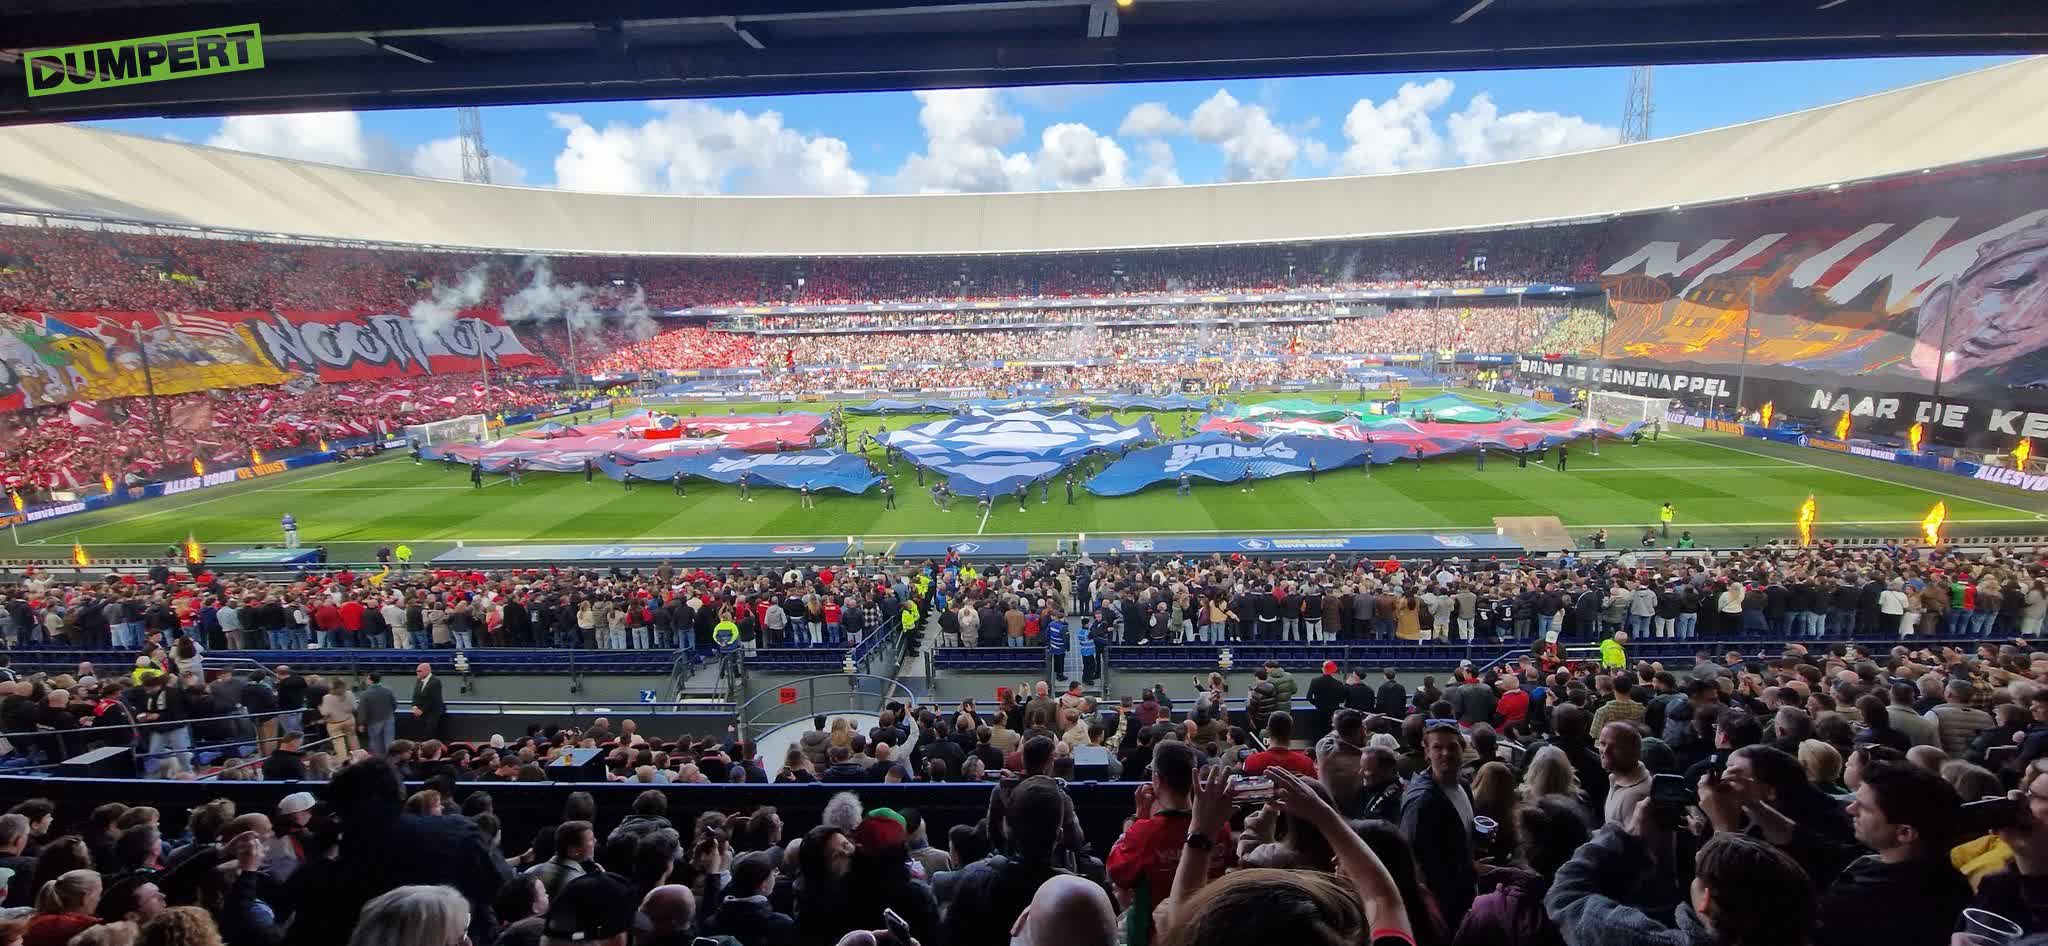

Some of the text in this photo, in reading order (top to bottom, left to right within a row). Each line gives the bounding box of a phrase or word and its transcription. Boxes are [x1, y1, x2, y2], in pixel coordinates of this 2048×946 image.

[1520, 360, 1563, 376] BRING
[1567, 365, 1587, 380] DE
[1811, 389, 1900, 419] NAAR
[1916, 401, 1969, 428] DE
[163, 476, 201, 495] ALLES
[1974, 465, 2026, 486] ALLES
